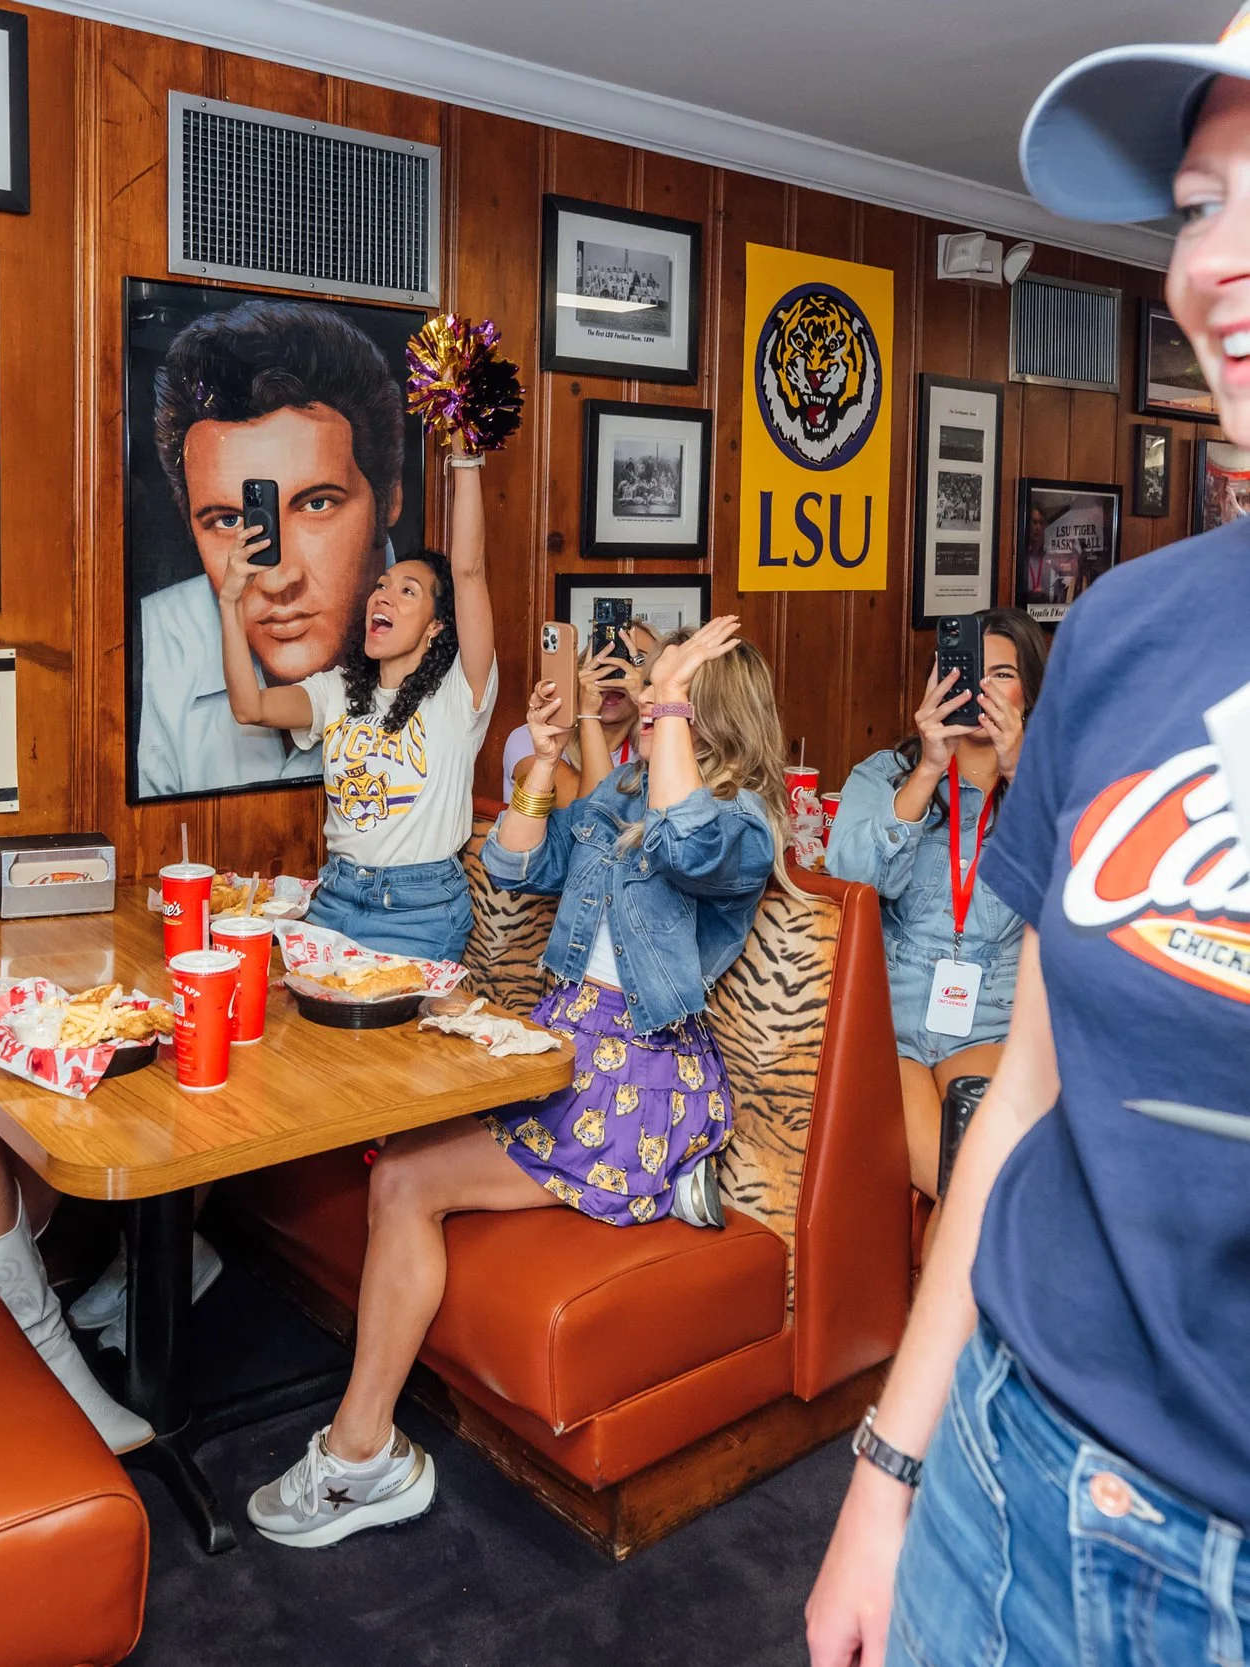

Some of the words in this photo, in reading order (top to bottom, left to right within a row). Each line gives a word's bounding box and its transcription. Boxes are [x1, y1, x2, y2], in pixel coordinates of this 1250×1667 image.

[614, 331, 630, 340] Football
[758, 490, 872, 569] LSU
[1056, 526, 1070, 538] LSU
[1073, 524, 1096, 536] TIGER
[346, 766, 365, 777] LSU
[229, 948, 247, 960] APP
[183, 985, 202, 998] APP
